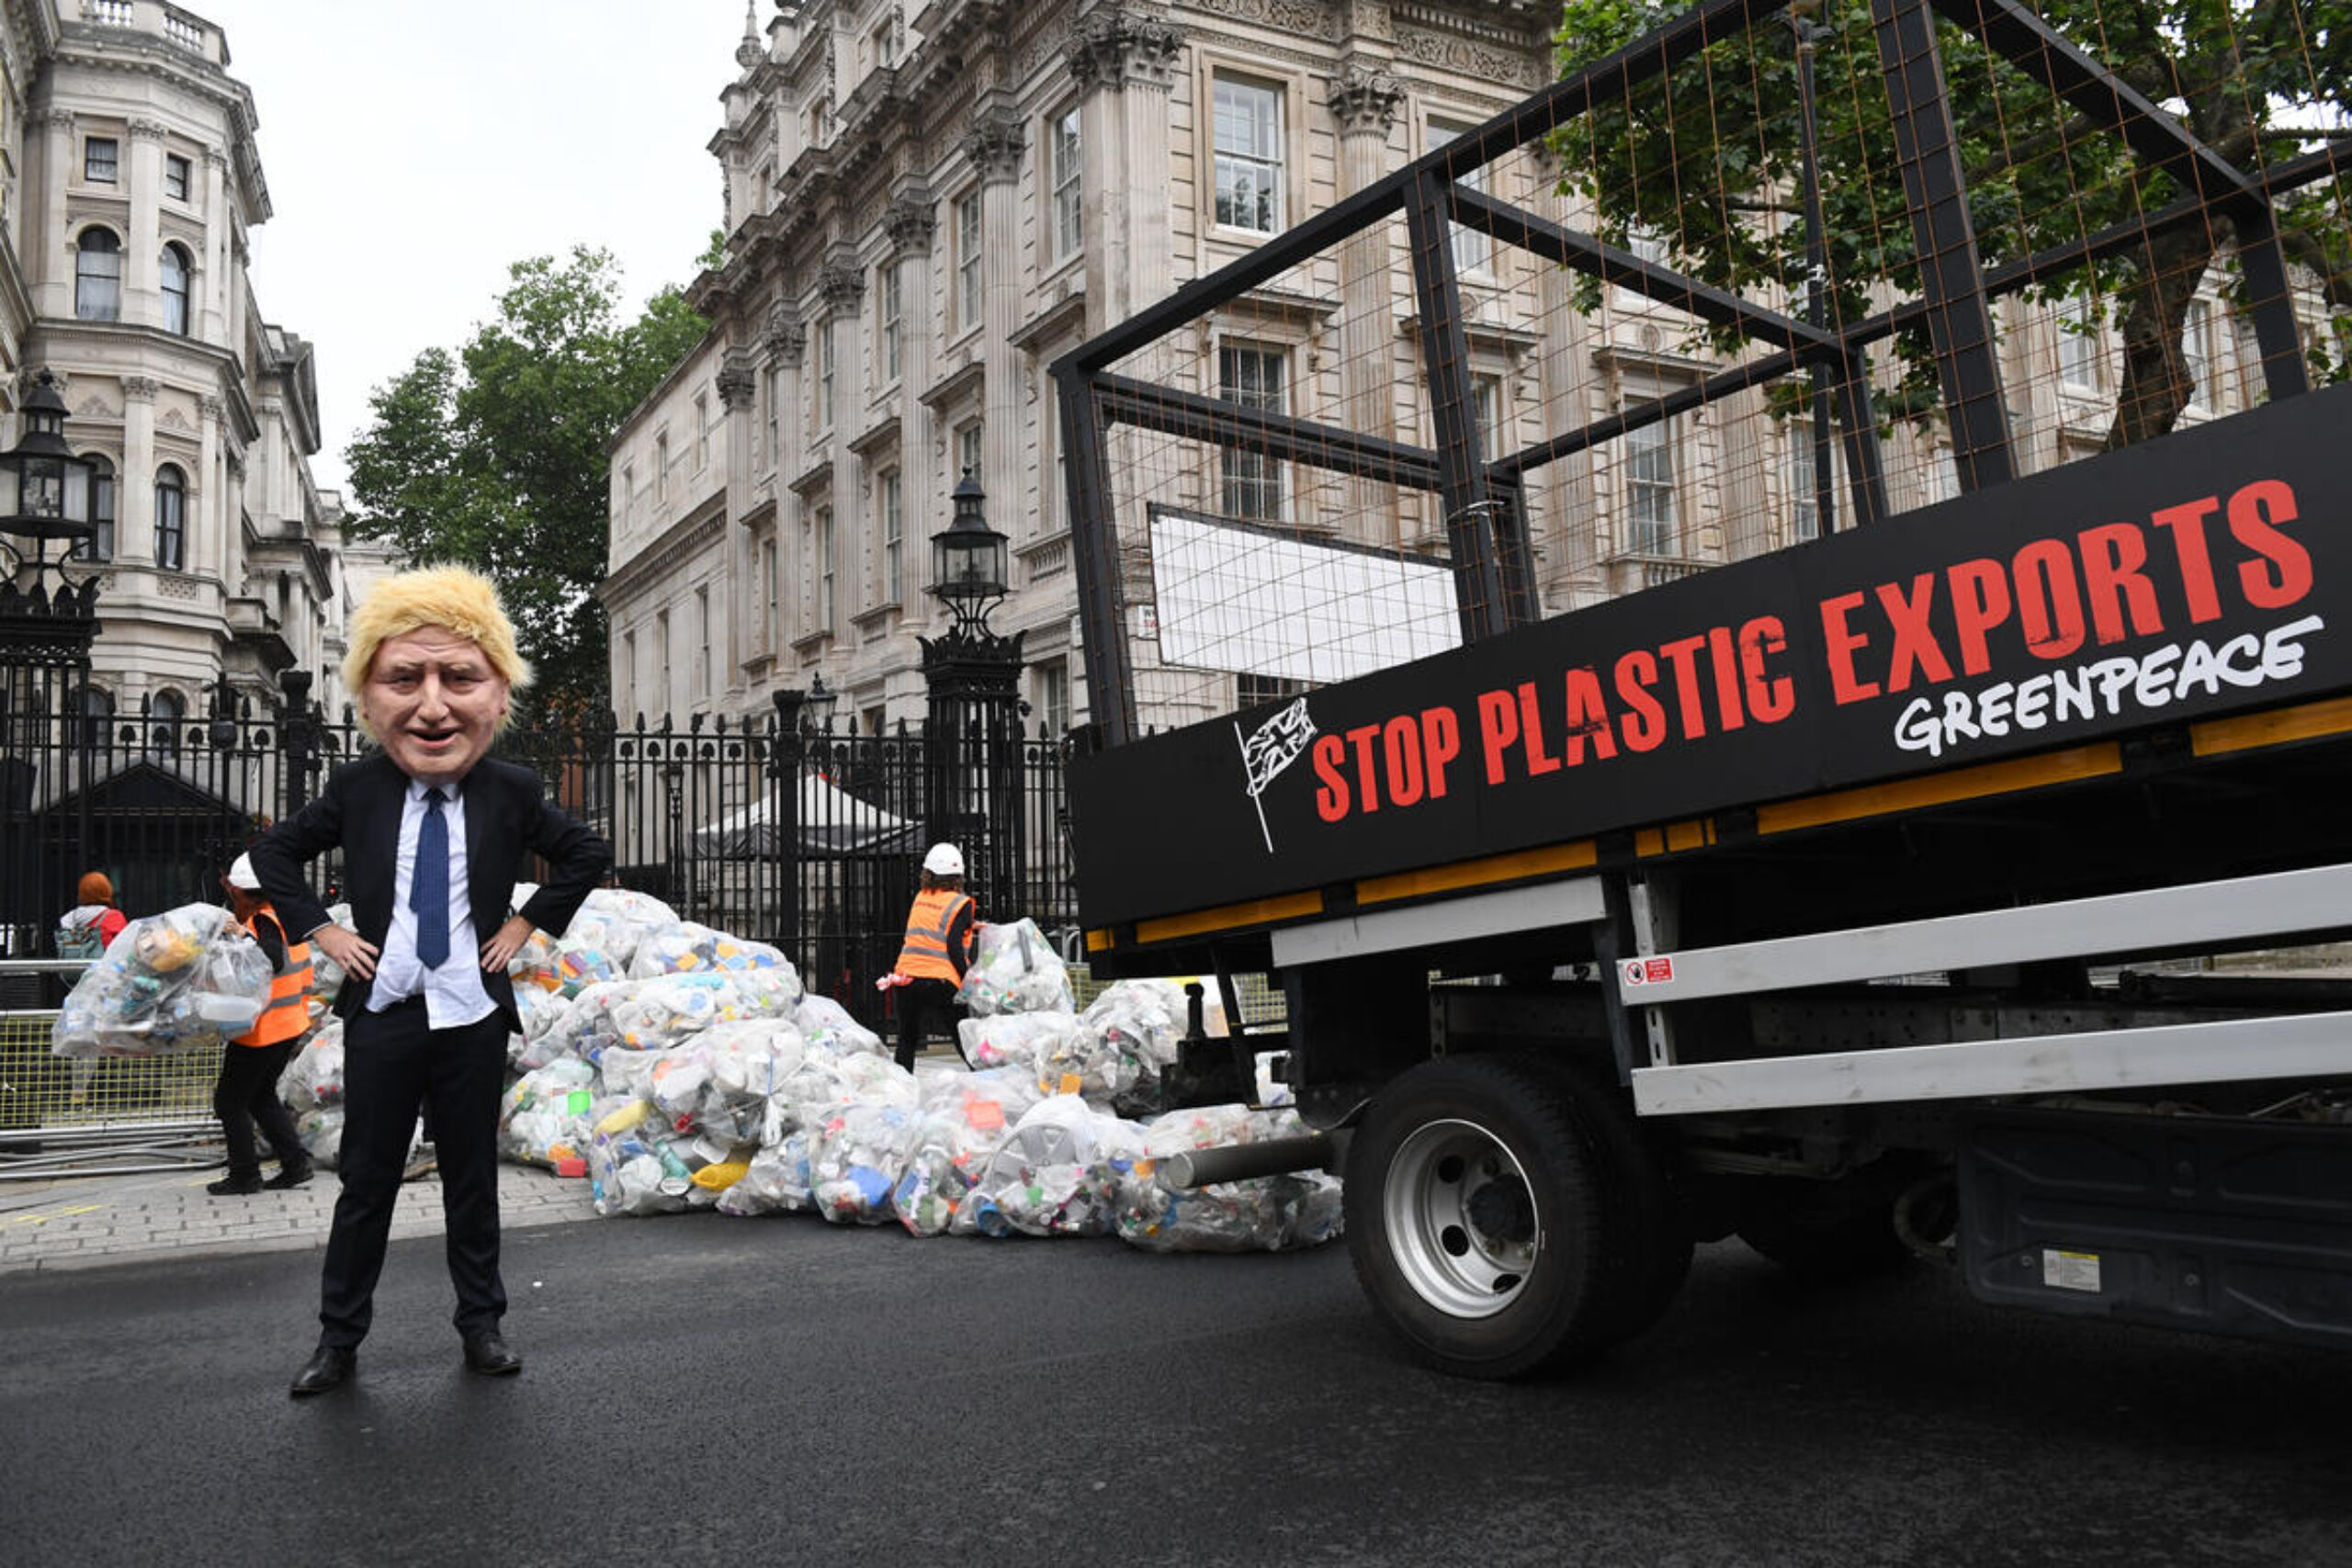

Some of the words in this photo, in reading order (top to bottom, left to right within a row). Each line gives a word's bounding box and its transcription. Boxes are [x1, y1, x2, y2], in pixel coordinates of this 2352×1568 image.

[1313, 706, 1460, 822] STOP
[1478, 616, 1795, 784] PLASTIC
[1820, 479, 2313, 705] EXPORTS
[1894, 615, 2324, 757] GREENPEACE
